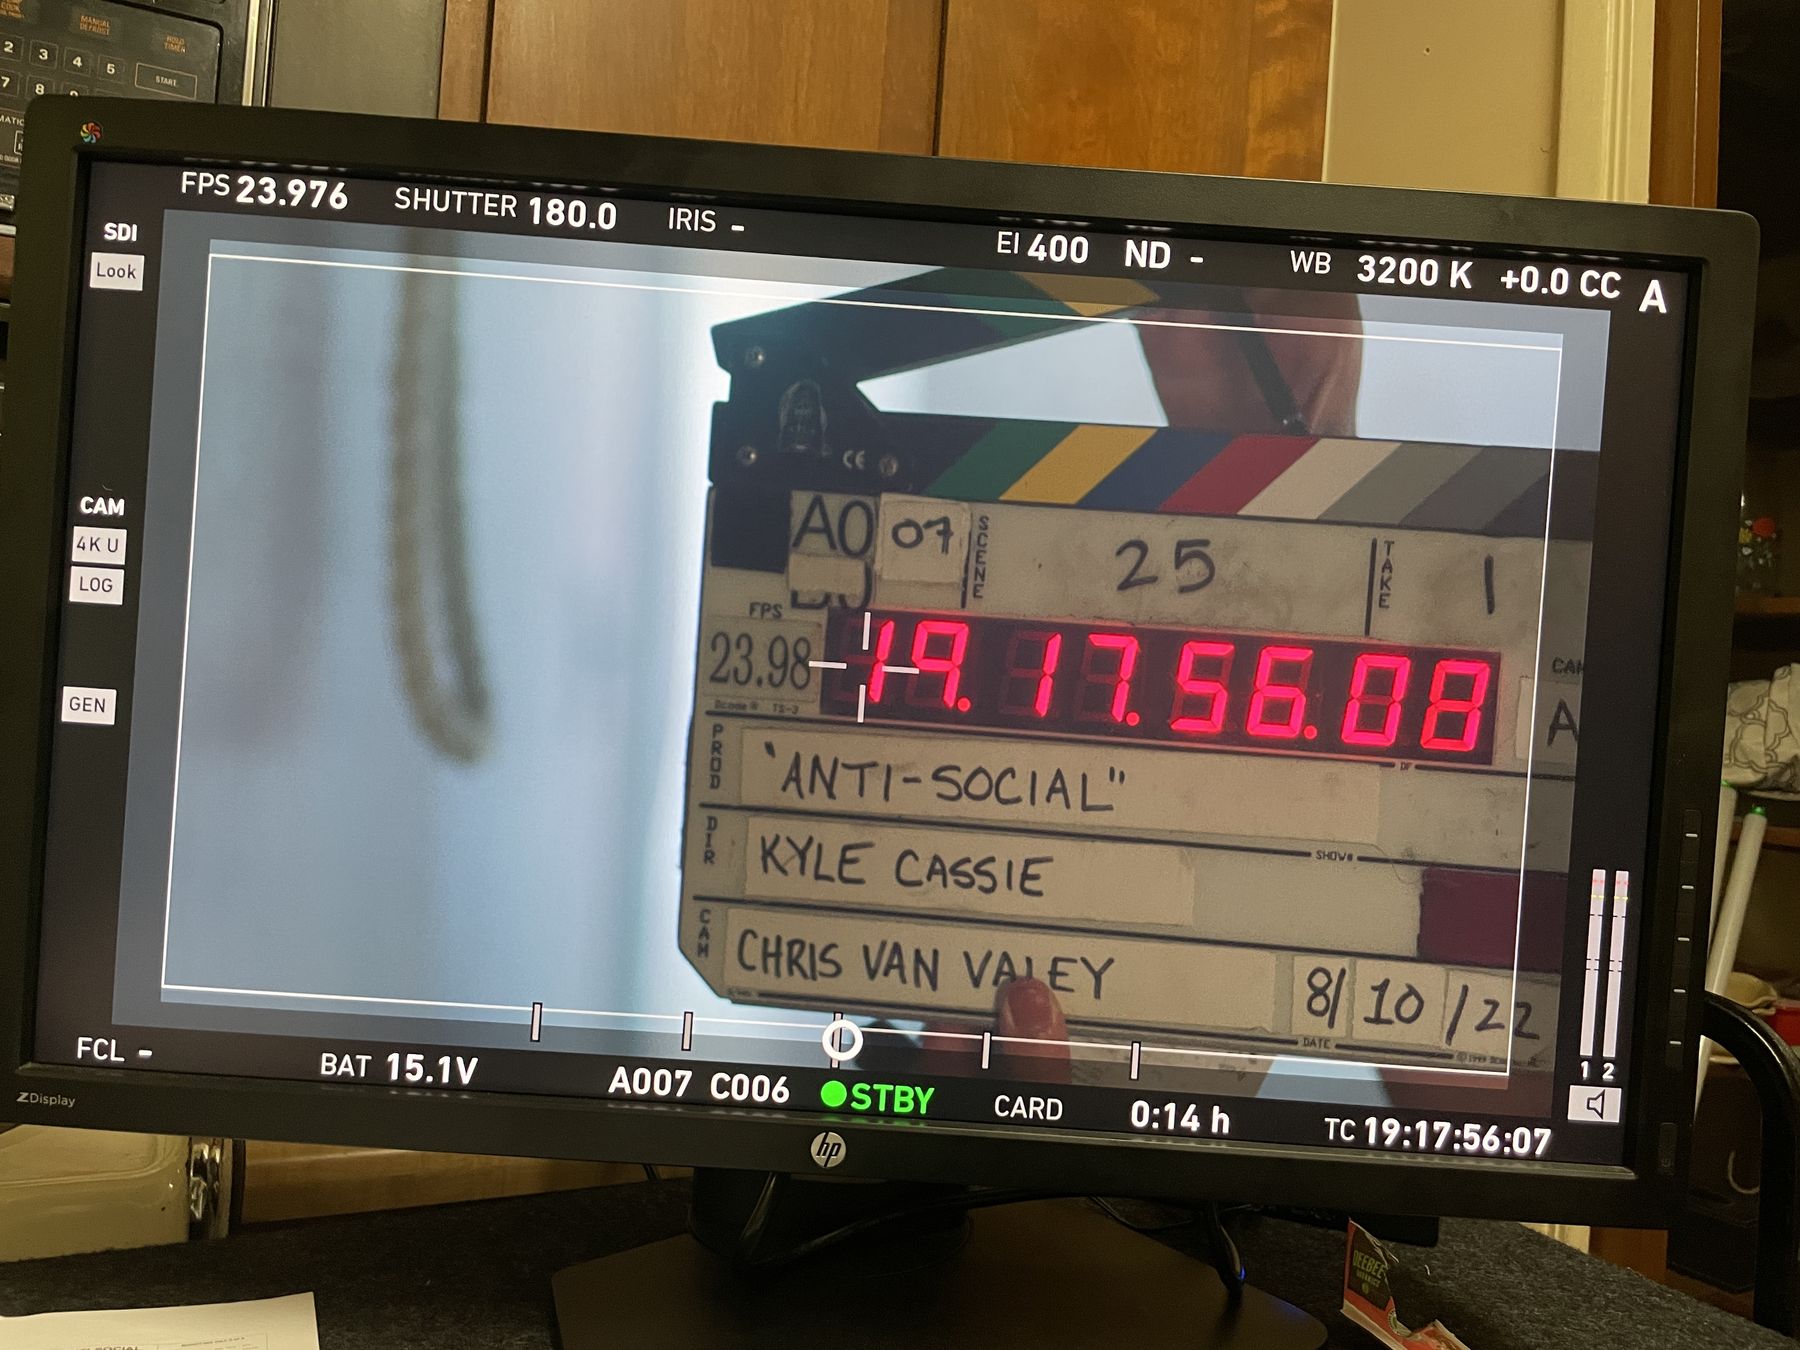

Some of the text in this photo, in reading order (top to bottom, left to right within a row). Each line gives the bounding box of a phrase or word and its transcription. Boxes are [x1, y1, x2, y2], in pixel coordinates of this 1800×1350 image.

[4, 41, 116, 75] 2 3 4 5
[1, 76, 45, 95] 7 8
[155, 75, 177, 88] START
[181, 171, 349, 211] FPS 23.976
[394, 187, 618, 231] SHUTTER 180.0
[668, 207, 717, 232] IRIS
[103, 222, 138, 242] SDI
[997, 231, 1089, 265] EI 400
[96, 261, 137, 281] Look
[1124, 239, 1171, 271] ND
[1290, 250, 1473, 289] WB 3200 K
[1500, 266, 1621, 299] +0.0 CC
[1638, 279, 1668, 314] A
[80, 496, 125, 516] CAM
[792, 494, 875, 558] A0
[891, 516, 954, 555] 07
[972, 514, 990, 600] SCENE
[1115, 539, 1217, 594] 25
[79, 575, 113, 593] LOG
[1376, 540, 1395, 610] TAKE
[749, 602, 783, 618] FPS
[709, 631, 811, 690] 23.98
[69, 696, 106, 713] GEN
[1546, 698, 1579, 746] A
[709, 723, 724, 789] PROD
[703, 815, 718, 865] DIR
[760, 834, 1054, 897] KYLE CASSIE
[737, 928, 843, 982] CHRIS
[863, 939, 940, 992] VAN
[76, 1036, 126, 1062] FCL
[1302, 1037, 1332, 1051] DATE
[320, 1051, 479, 1085] BAT 15.1V
[608, 1066, 791, 1104] A007 C006
[1579, 1061, 1615, 1080] 1 2
[850, 1083, 936, 1116] STBY
[993, 1094, 1064, 1121] CARD
[1130, 1099, 1231, 1135] 0:14 h
[813, 1131, 844, 1168] hp
[1325, 1116, 1553, 1158] TC 19:17:56:07
